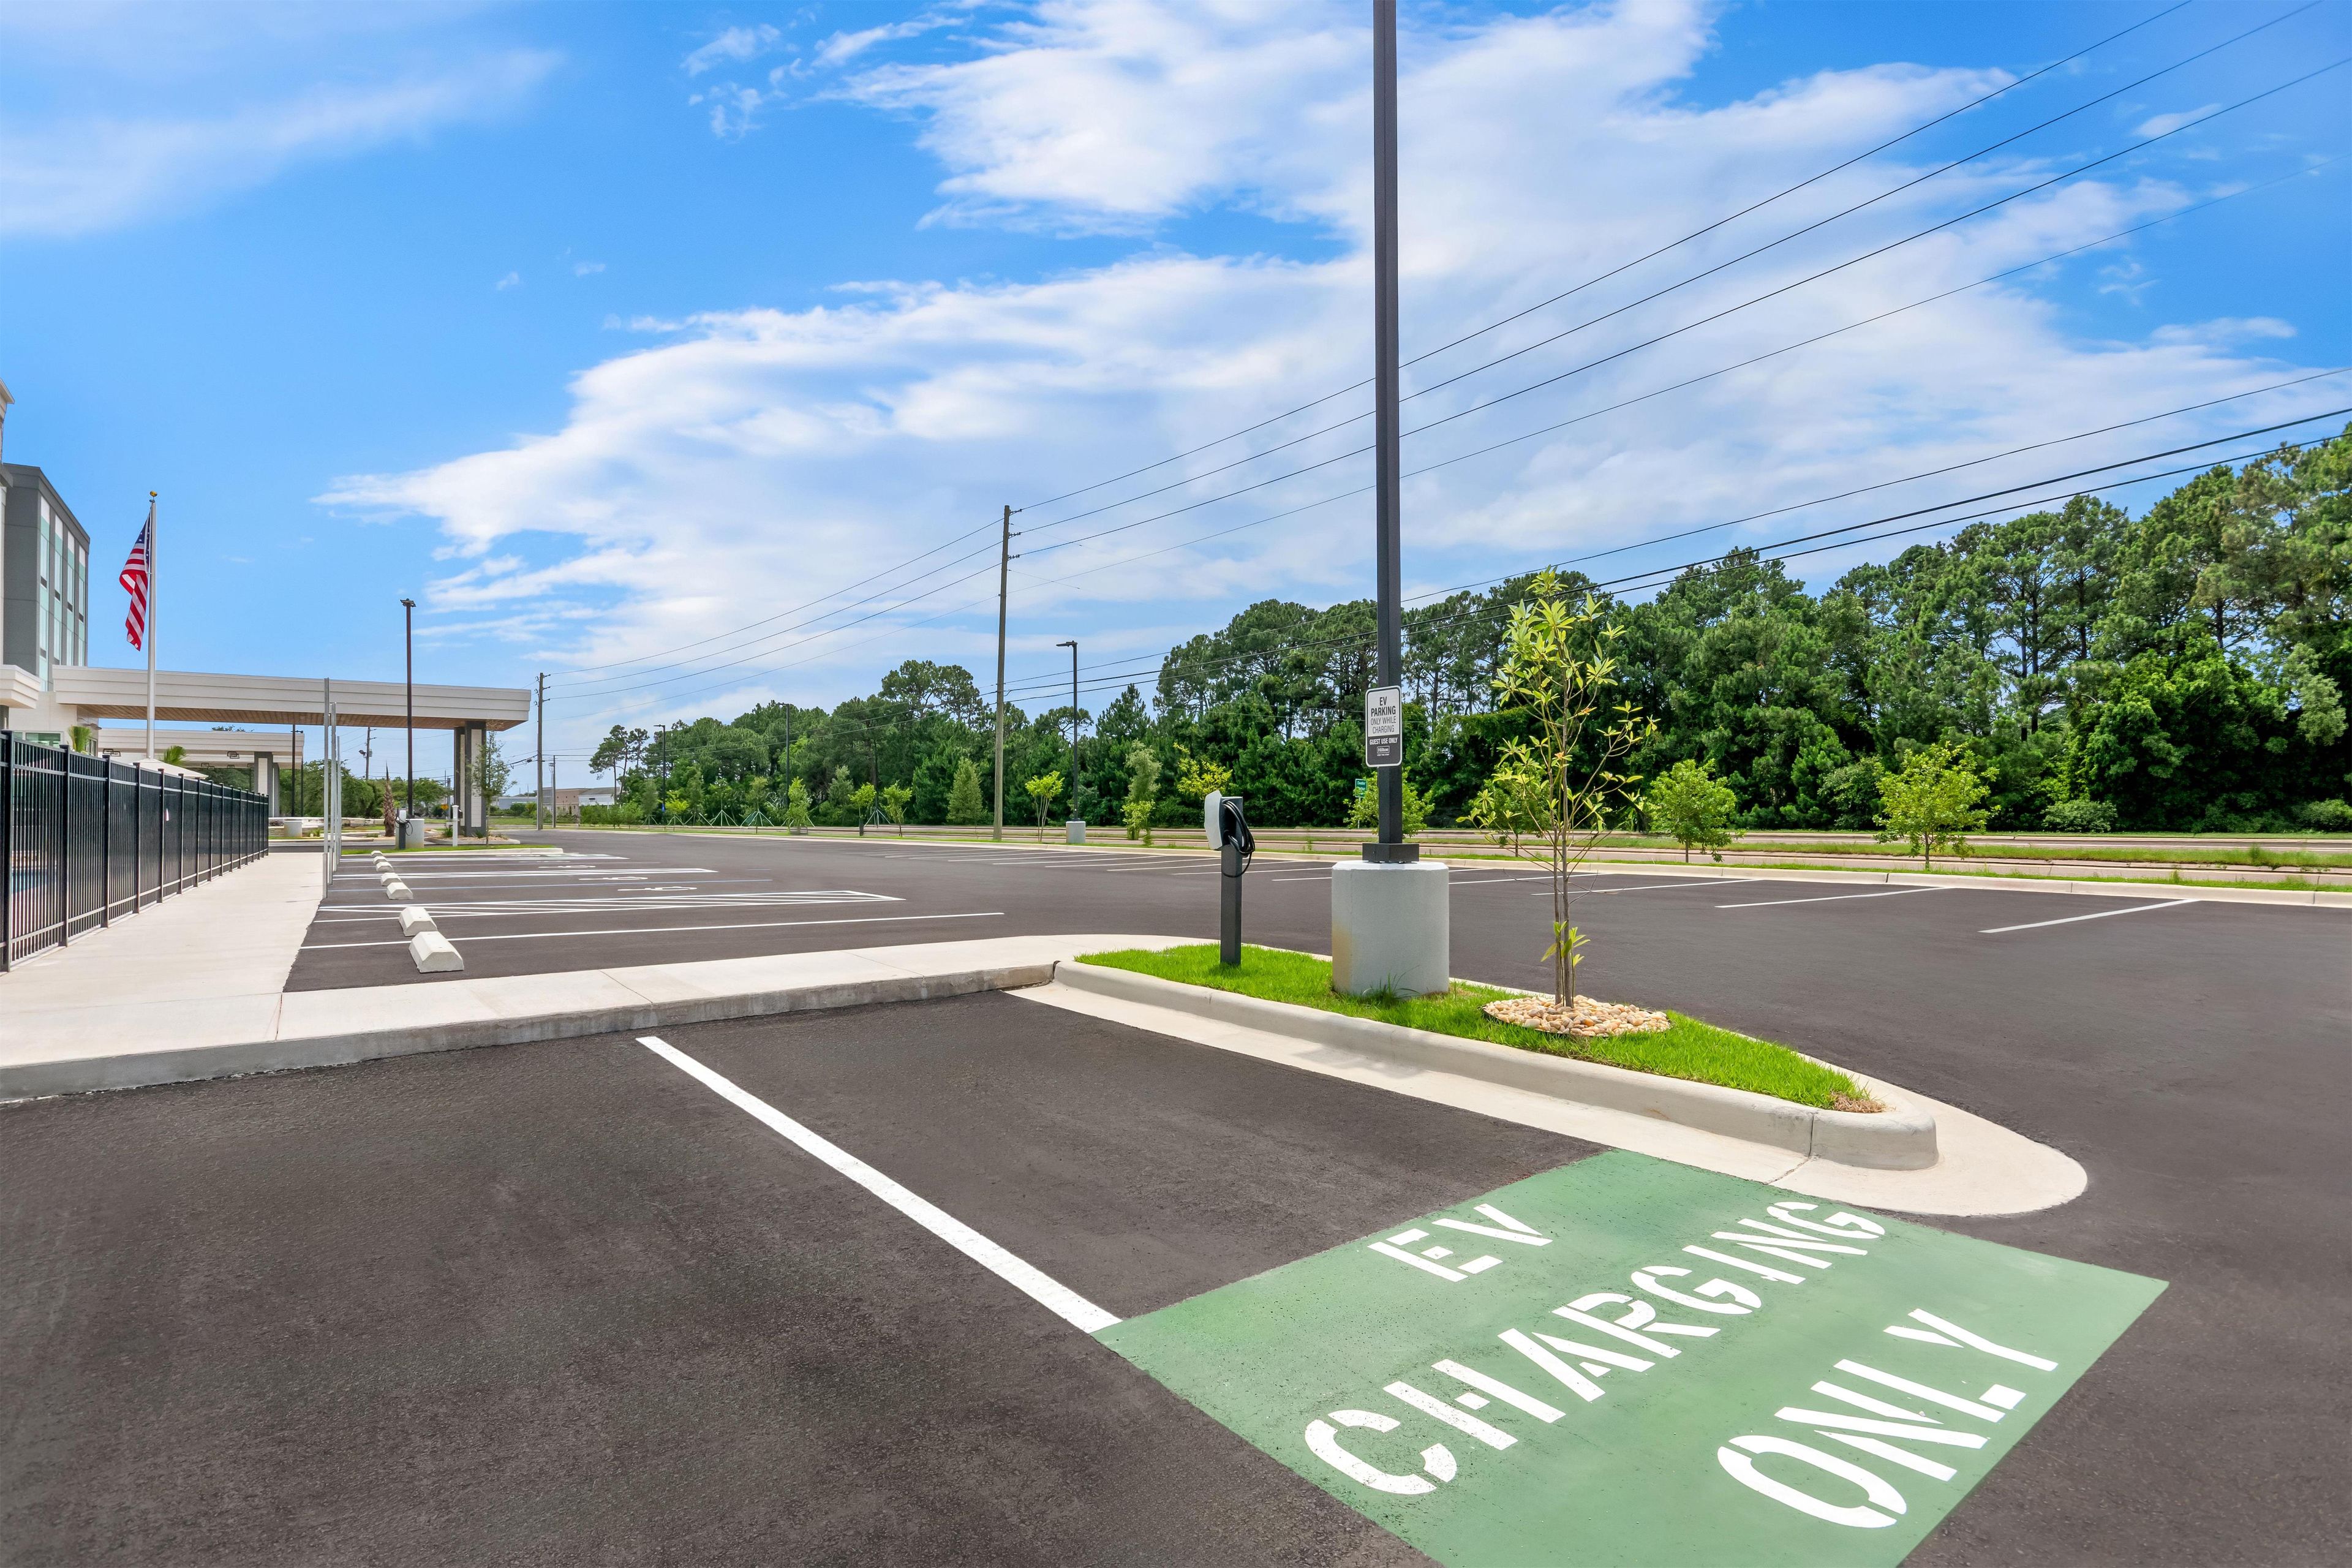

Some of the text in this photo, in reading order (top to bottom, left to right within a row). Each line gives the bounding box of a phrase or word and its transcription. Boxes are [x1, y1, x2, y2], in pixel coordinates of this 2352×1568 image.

[1371, 706, 1396, 717] PARKING
[1379, 696, 1387, 706] EV
[1373, 725, 1395, 734] CHARGING
[1368, 1204, 1553, 1283] EV
[1305, 1201, 1885, 1495] CHARGING
[1717, 1309, 2059, 1528] ONLY
